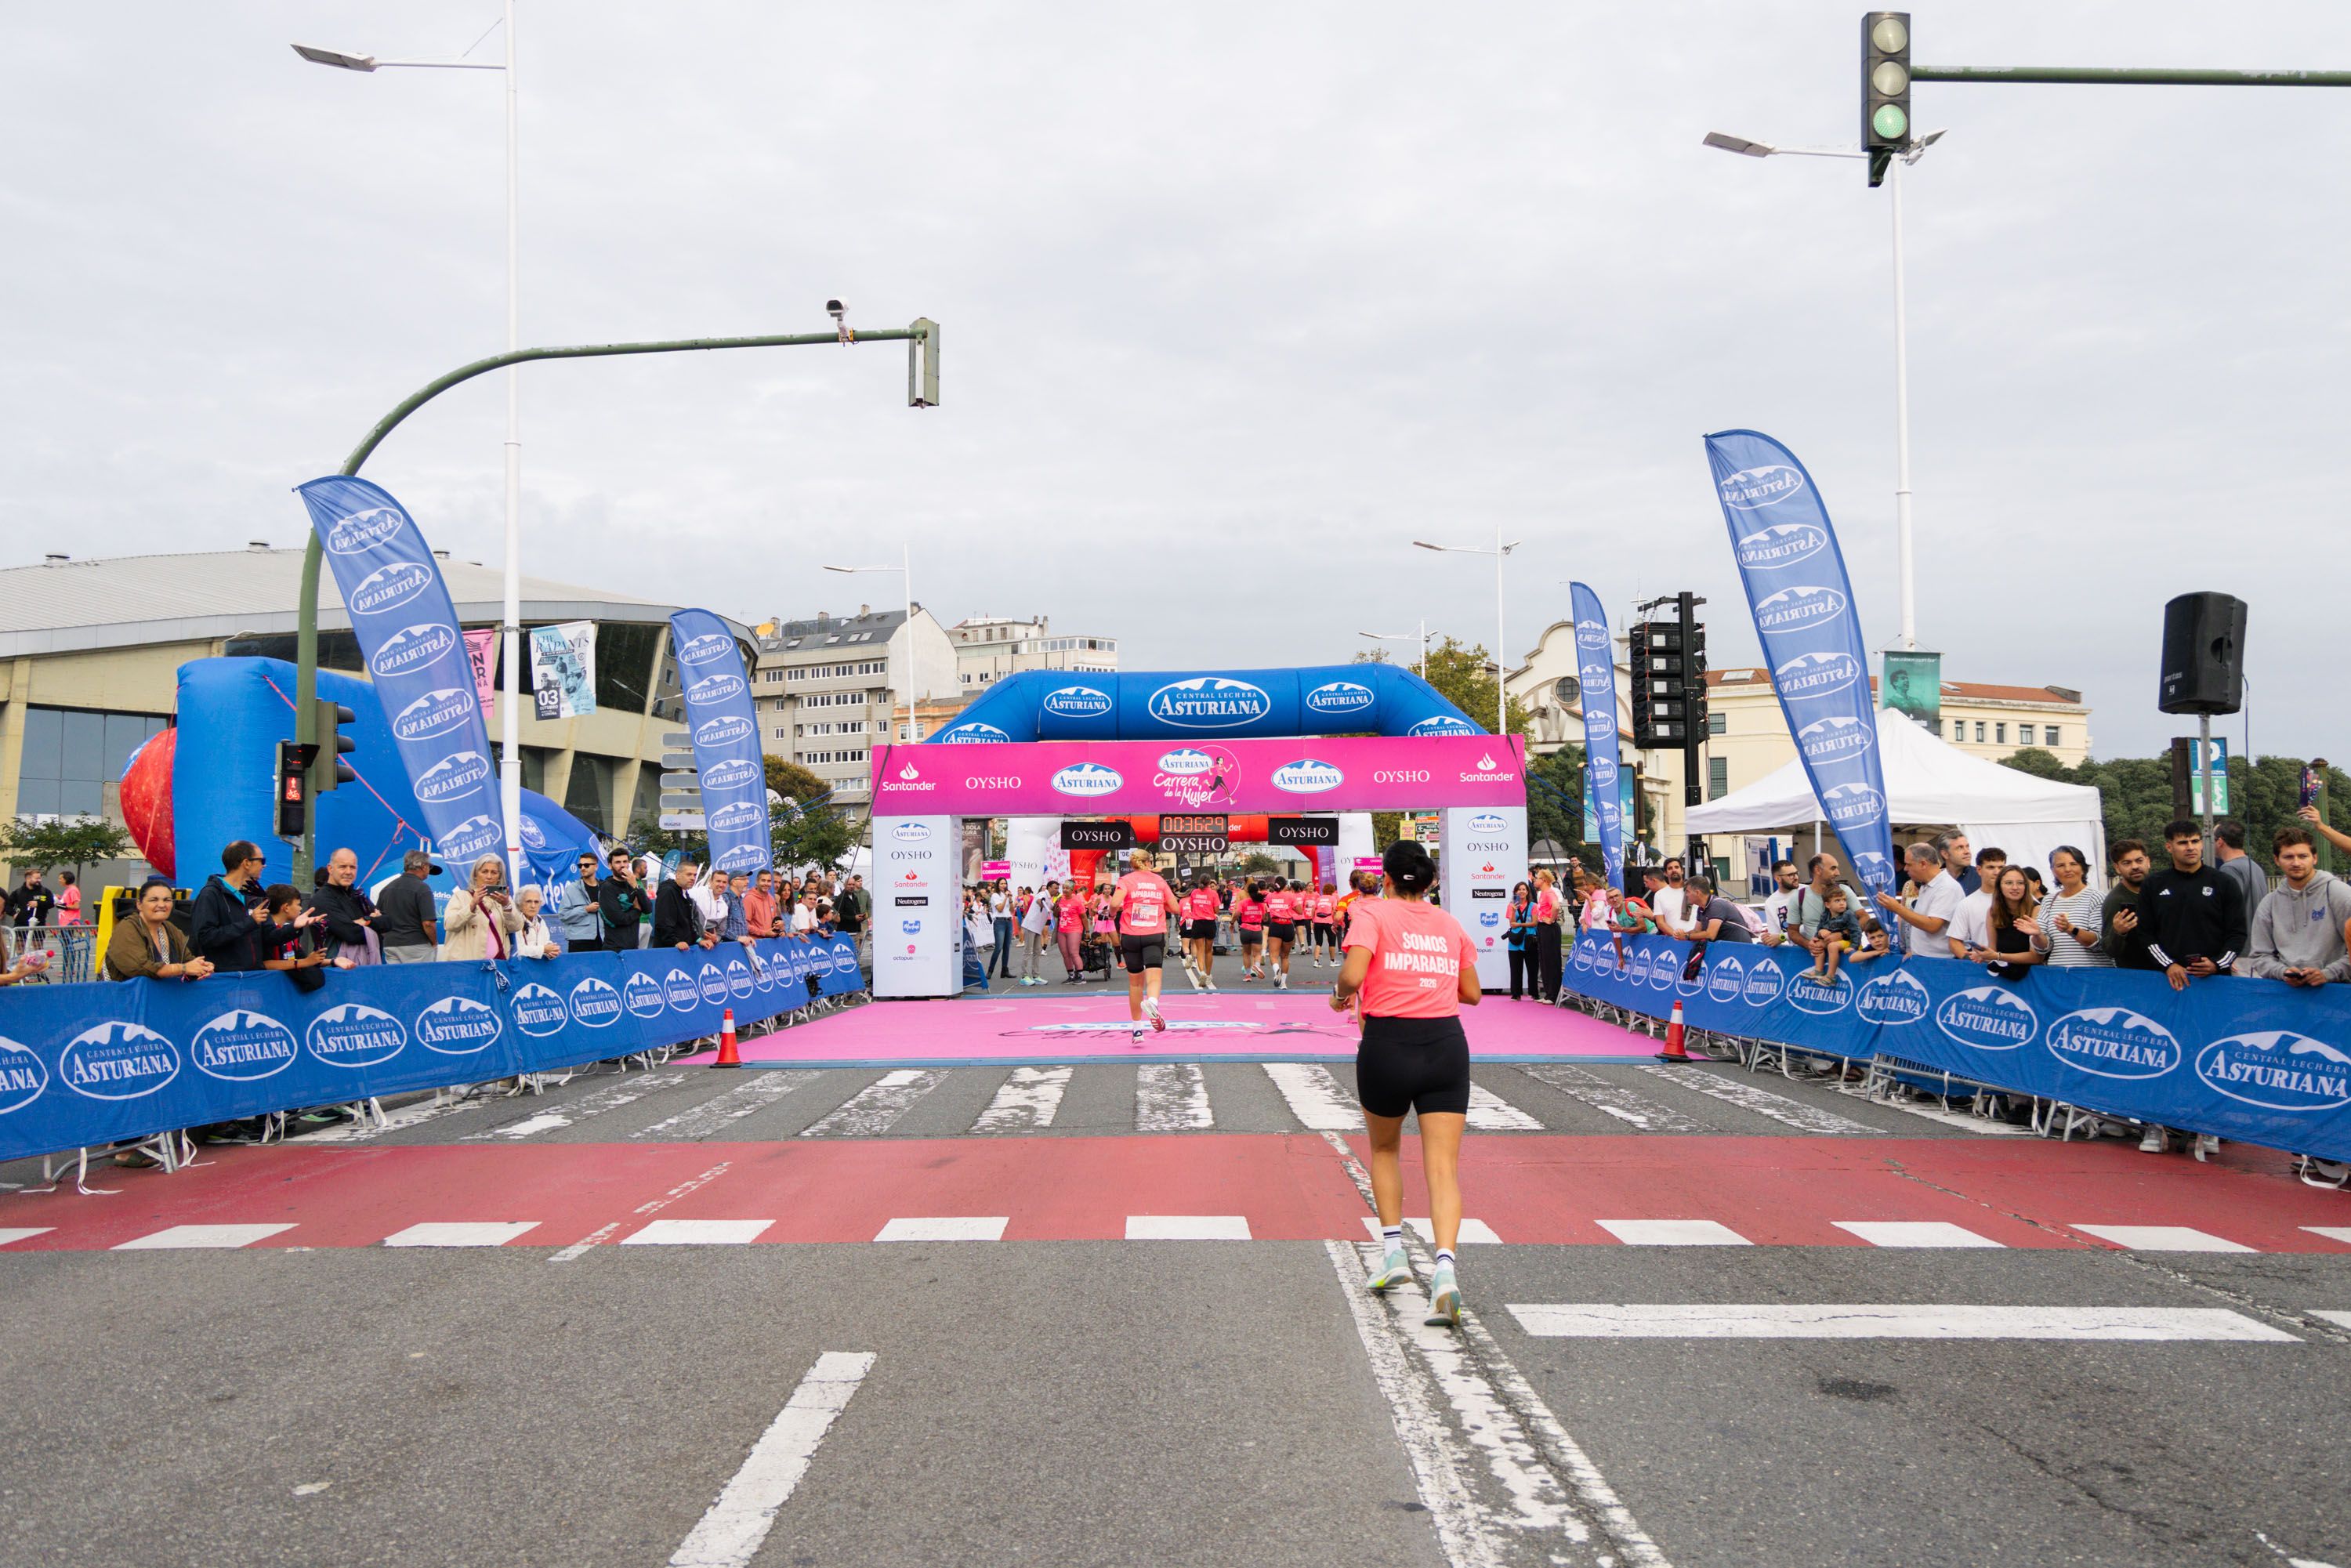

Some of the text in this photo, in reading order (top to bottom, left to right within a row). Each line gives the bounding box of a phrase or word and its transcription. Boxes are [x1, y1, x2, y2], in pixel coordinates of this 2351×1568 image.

[538, 690, 559, 705] 03
[1049, 696, 1107, 710] ASTURIANA
[1157, 694, 1262, 715] ASTURIANA
[1312, 693, 1369, 708] ASTURIANA
[1162, 758, 1209, 769] ASTURIANA
[965, 777, 1022, 789] OYSHO
[1057, 775, 1118, 788] ASTURIANA
[1154, 773, 1200, 788] Carrera
[1277, 772, 1339, 784] ASTURIANA
[1374, 770, 1430, 783] OYSHO
[1460, 772, 1514, 783] Santander
[882, 780, 936, 791] Santander
[1165, 785, 1215, 808] de la Mujer
[1164, 817, 1224, 832] 00:36:29
[1471, 820, 1505, 829] ASTURIANA
[895, 829, 928, 838] ASTURIANA
[1071, 830, 1121, 842] OYSHO
[1279, 827, 1329, 838] OYSHO
[1162, 837, 1226, 851] OYSHO
[1467, 842, 1509, 852] OYSHO
[891, 851, 932, 860] OYSHO
[1131, 890, 1162, 900] IMPARABLES
[1402, 931, 1448, 953] SOMOS
[1384, 952, 1459, 977] IMPARABLES
[1419, 978, 1437, 987] 2026
[1650, 968, 1675, 982] ASTURIANA
[1710, 972, 1740, 993] ASTURIANA
[703, 981, 726, 996] ASTURIANA
[730, 977, 752, 990] ASTURIANA
[1744, 976, 1777, 995] ASTURIANA
[668, 987, 697, 1003] ASTURIANA
[1789, 980, 1846, 1005] ASTURIANA
[576, 998, 619, 1017] ASTURIANA
[629, 992, 663, 1009] ASTURIANA
[1962, 1002, 2029, 1020] CENTRAL LECHERA
[326, 1022, 393, 1034] CENTRAL LECHERA
[1942, 1002, 2027, 1040] ASTURIANA
[251, 1030, 284, 1040] LECHERA
[425, 1019, 497, 1042] ASTURIANA
[2076, 1025, 2168, 1048] CENTRAL LECHERA
[316, 1029, 401, 1054] ASTURIANA
[2052, 1023, 2167, 1069] ASTURIANA
[86, 1047, 127, 1059] CENTRAL
[203, 1039, 292, 1066] ASTURIANA
[73, 1053, 174, 1085] ASTURIANA
[2234, 1051, 2348, 1075] CENTRAL LECHERA
[2204, 1049, 2349, 1098] ASTURIANA
